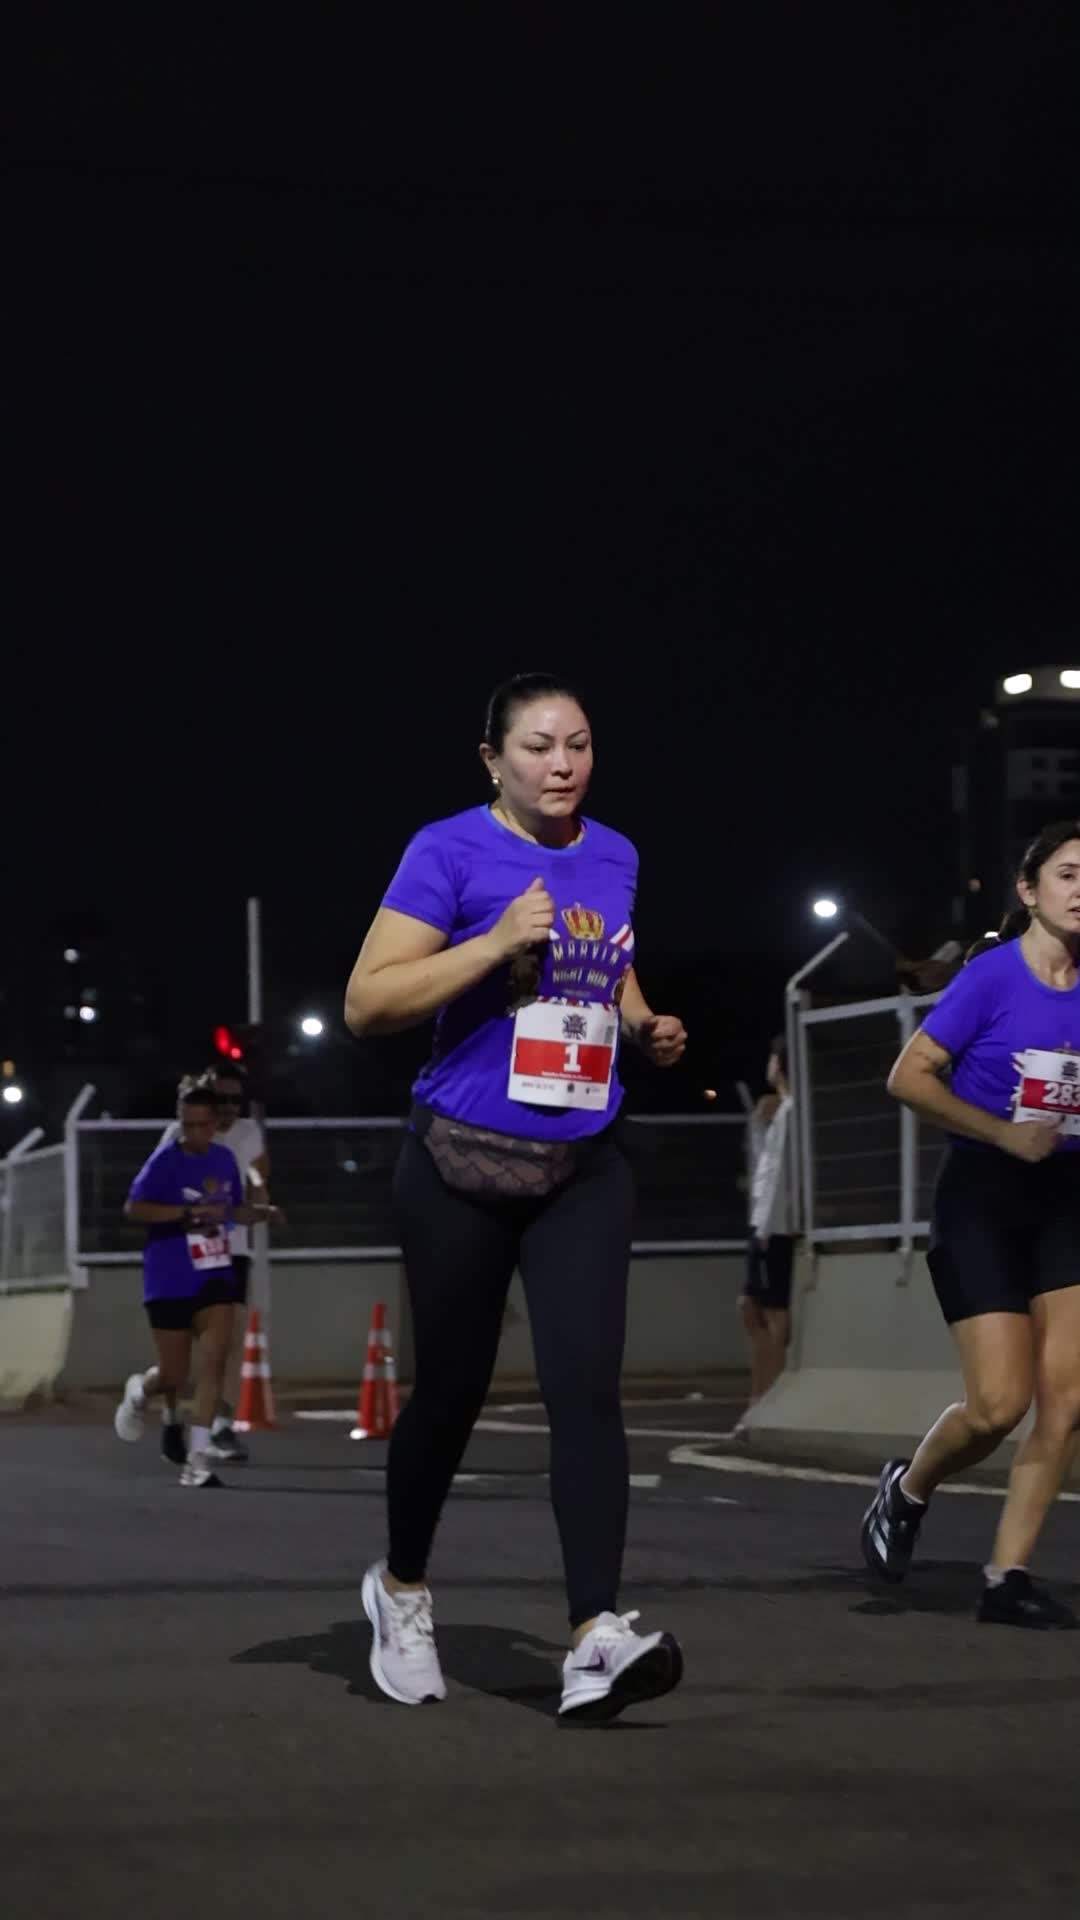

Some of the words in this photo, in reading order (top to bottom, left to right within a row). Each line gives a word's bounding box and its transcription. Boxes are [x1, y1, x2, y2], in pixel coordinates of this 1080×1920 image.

[552, 940, 620, 965] MARVIN
[552, 967, 583, 984] NIGHT
[586, 968, 609, 988] RUN
[563, 1043, 582, 1073] 1
